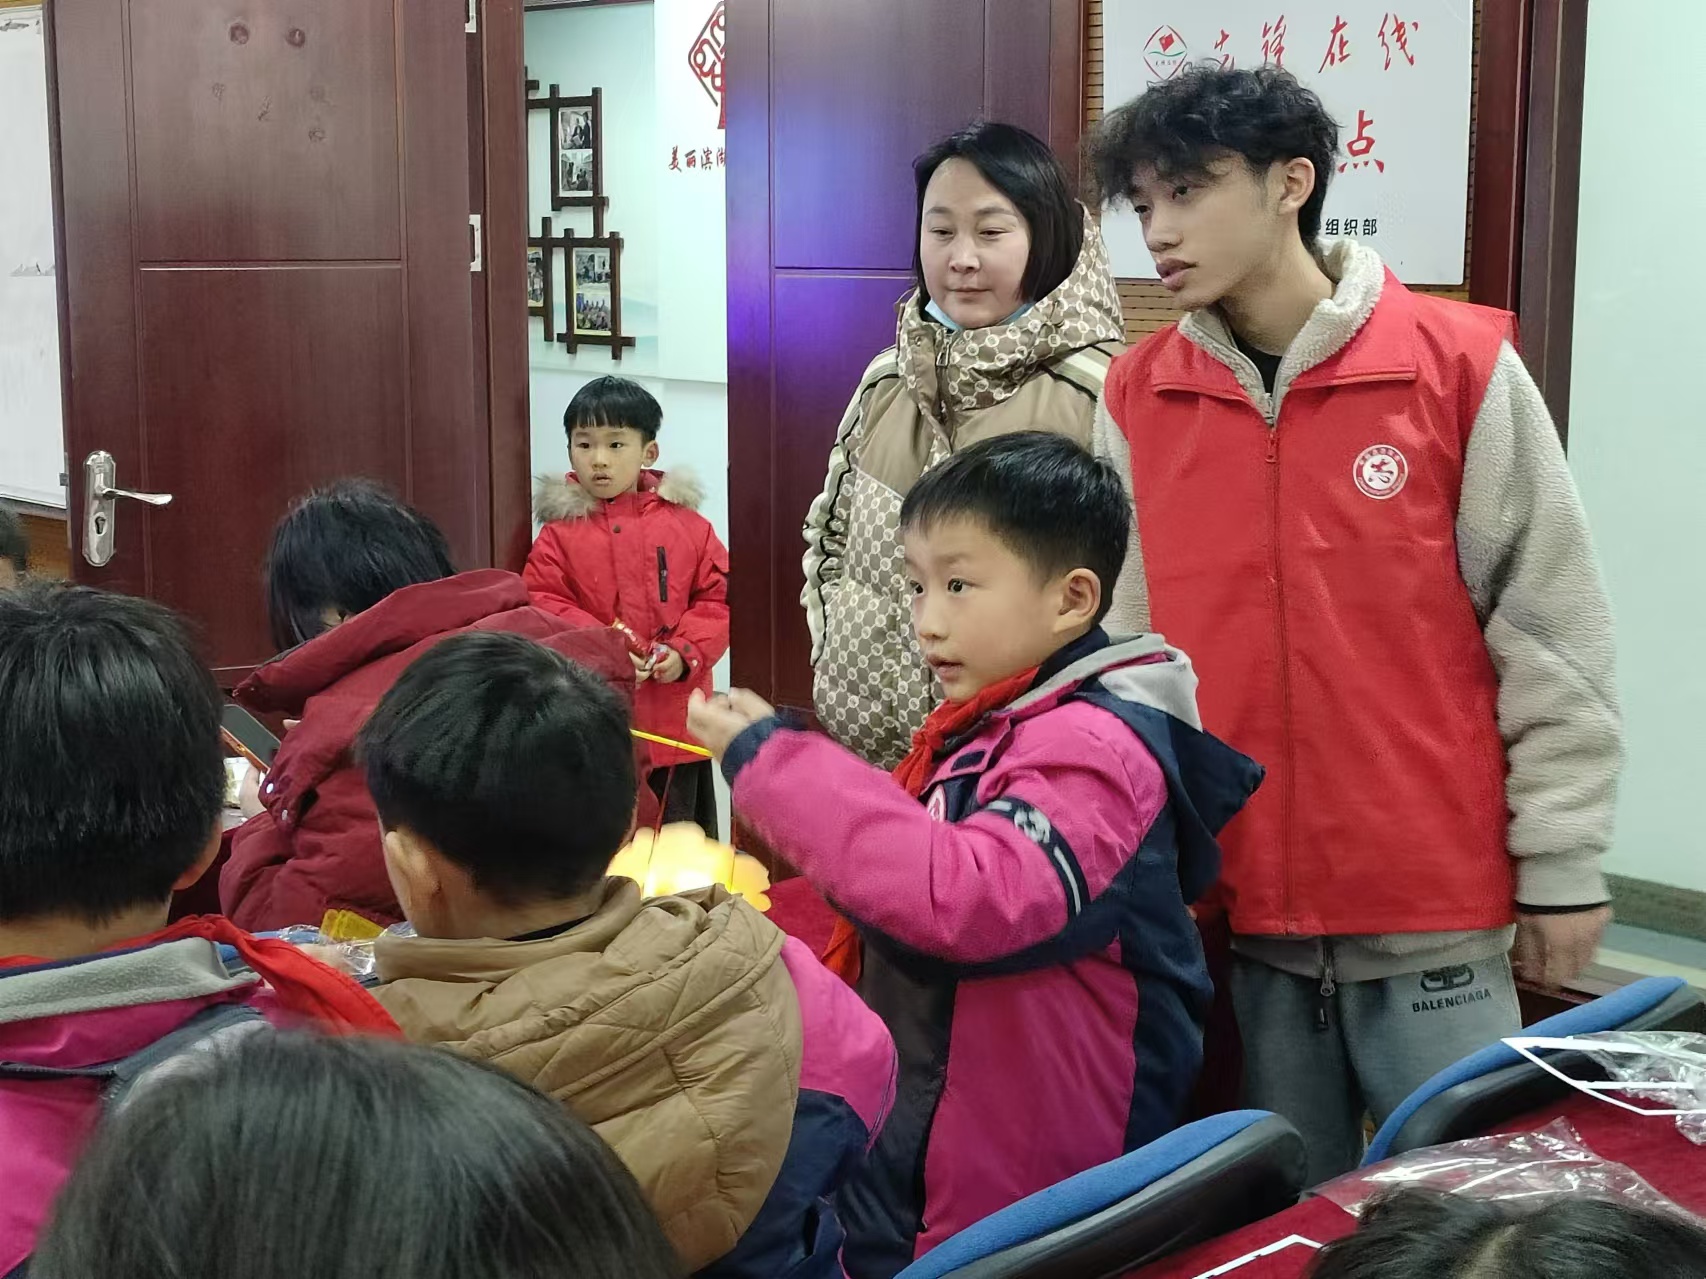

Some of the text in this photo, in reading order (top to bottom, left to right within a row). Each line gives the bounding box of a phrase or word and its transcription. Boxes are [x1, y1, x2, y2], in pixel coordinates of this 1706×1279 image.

[1338, 109, 1385, 174] 点
[1325, 218, 1378, 236] 组织部
[1412, 988, 1492, 1012] BALENCIAGA
